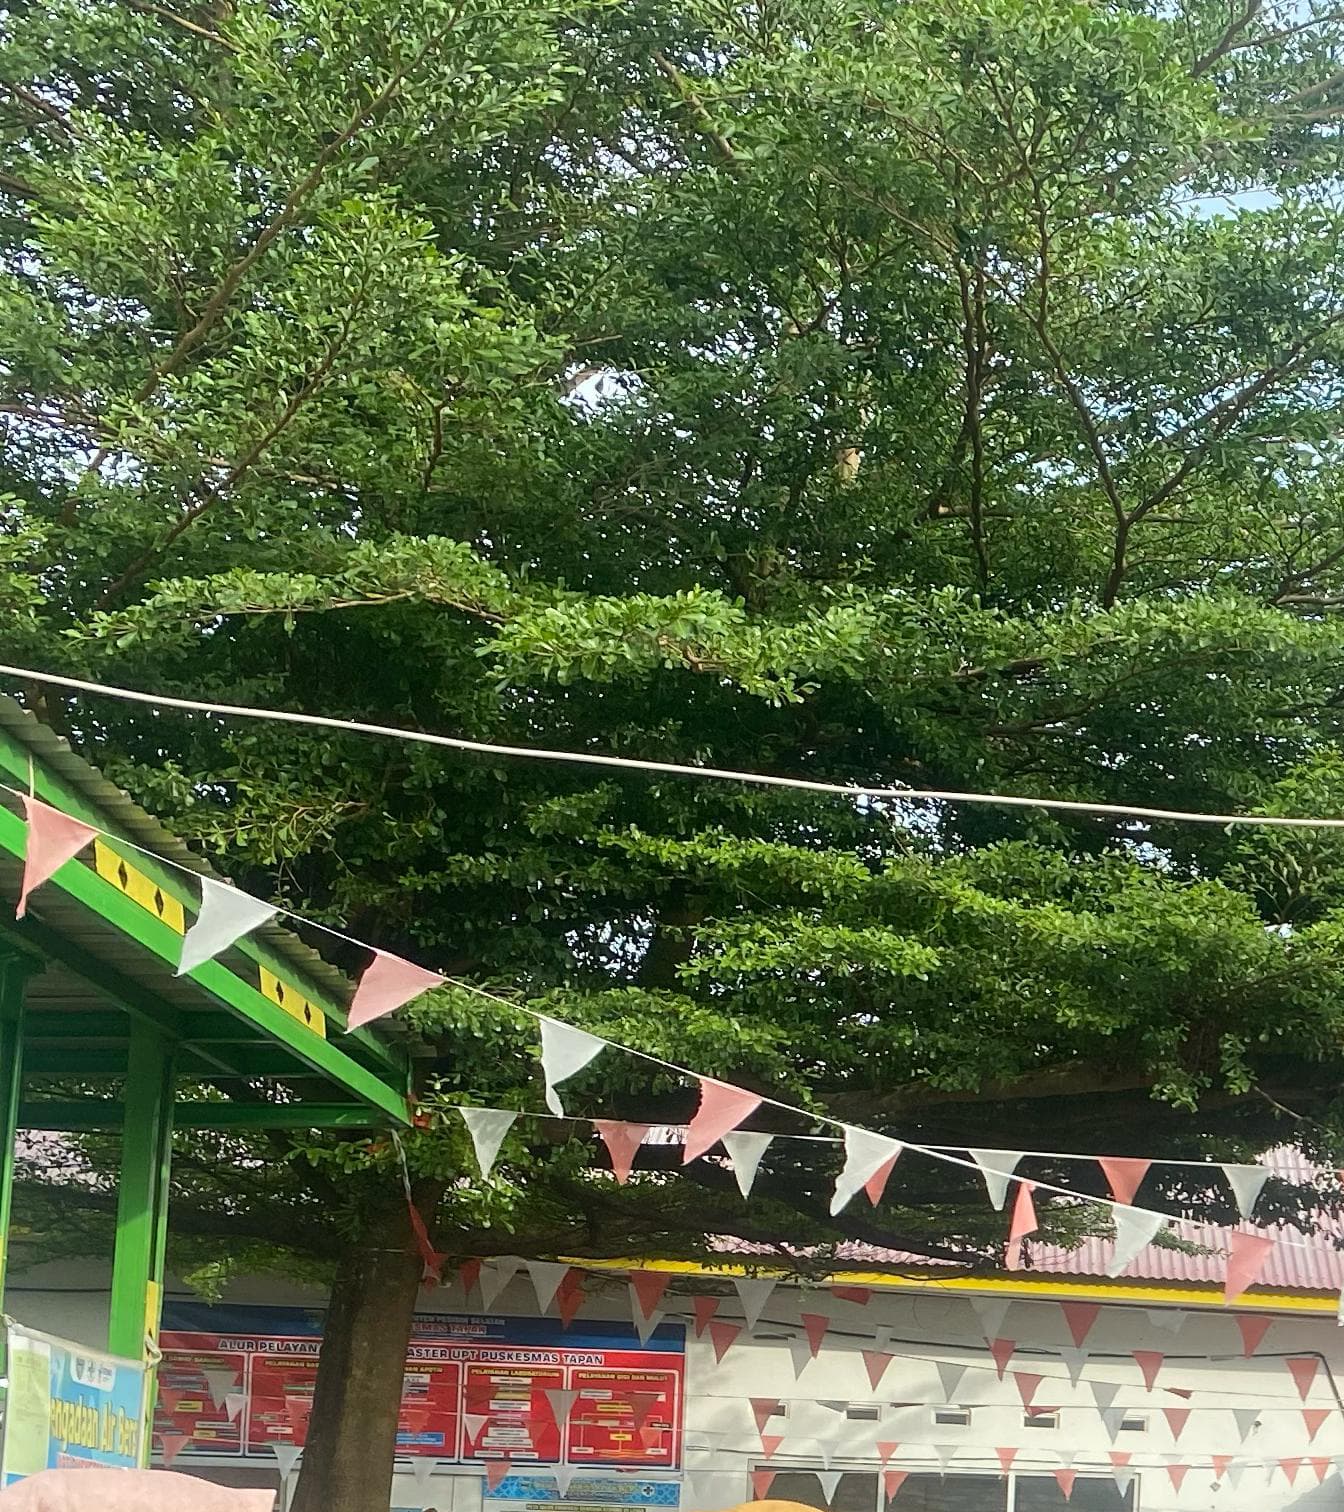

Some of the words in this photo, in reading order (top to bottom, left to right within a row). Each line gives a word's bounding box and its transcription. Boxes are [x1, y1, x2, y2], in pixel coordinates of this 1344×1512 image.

[218, 1340, 255, 1351] ALUR
[257, 1341, 321, 1353] PELAYAN
[406, 1348, 448, 1360] ASTER
[451, 1350, 477, 1361] UPT
[481, 1351, 560, 1364] PUSKESMAS
[563, 1354, 604, 1366] TAPAN
[50, 1394, 99, 1452] engadaan
